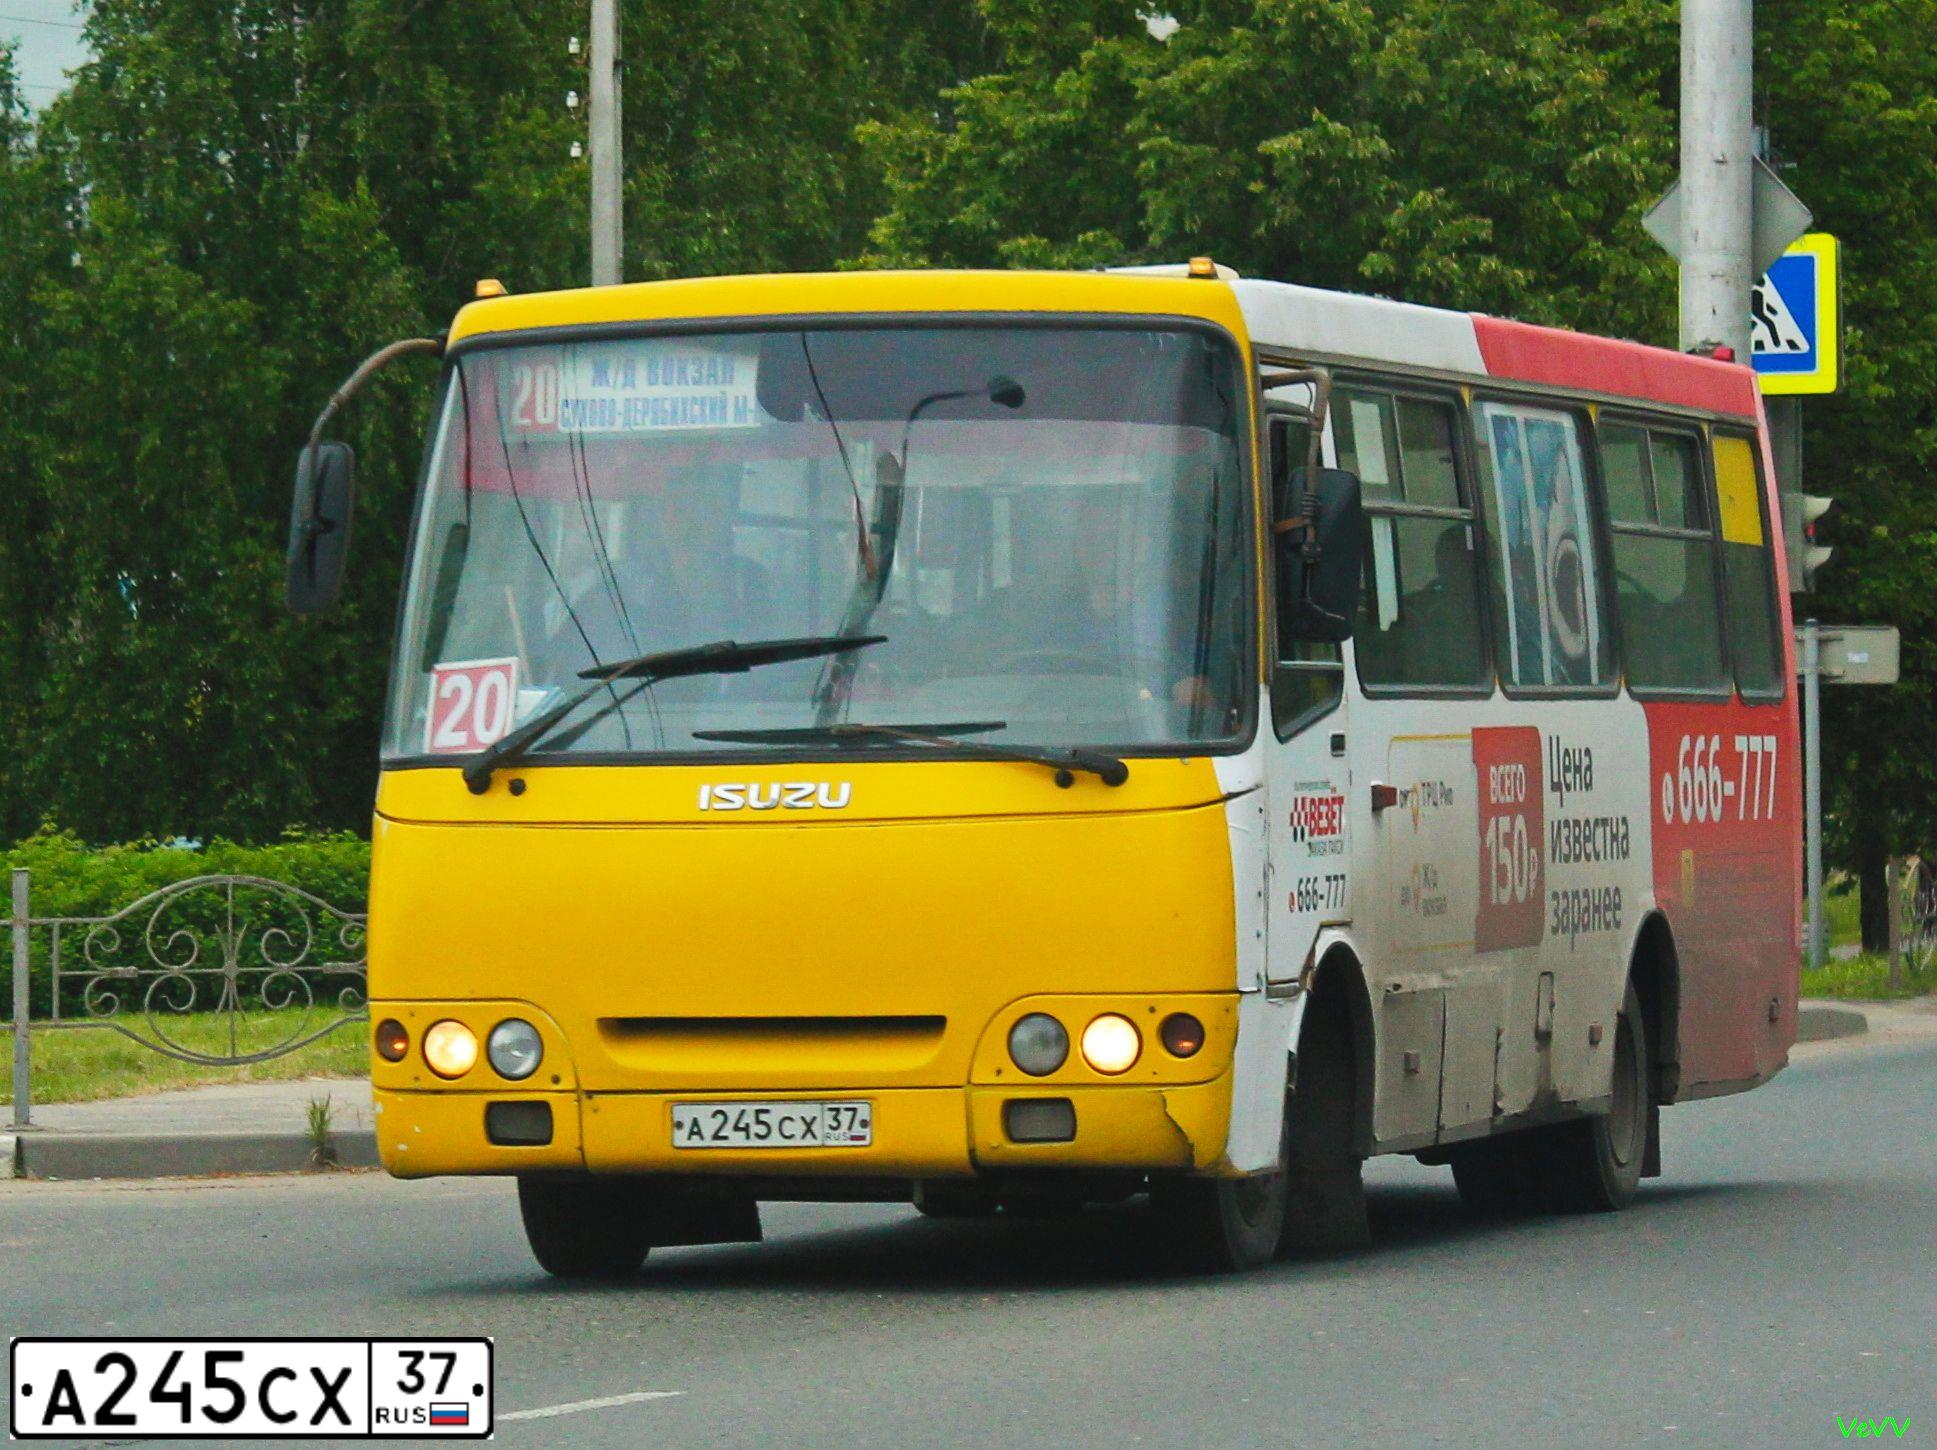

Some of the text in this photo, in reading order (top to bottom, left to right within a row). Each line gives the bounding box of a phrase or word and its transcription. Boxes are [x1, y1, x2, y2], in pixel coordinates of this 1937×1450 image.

[647, 355, 735, 386] ВОКЗАЛ
[511, 364, 557, 427] 20
[433, 670, 509, 748] 20
[1490, 764, 1526, 804] ВСЕГО
[1549, 735, 1593, 808] Цена
[1678, 734, 1777, 823] 666-777
[699, 783, 852, 810] ISUZU
[1550, 816, 1630, 864] известна
[1297, 874, 1346, 912] 666-777
[1550, 885, 1622, 950] заранее
[825, 1131, 849, 1141] RUS
[827, 1107, 858, 1131] 37
